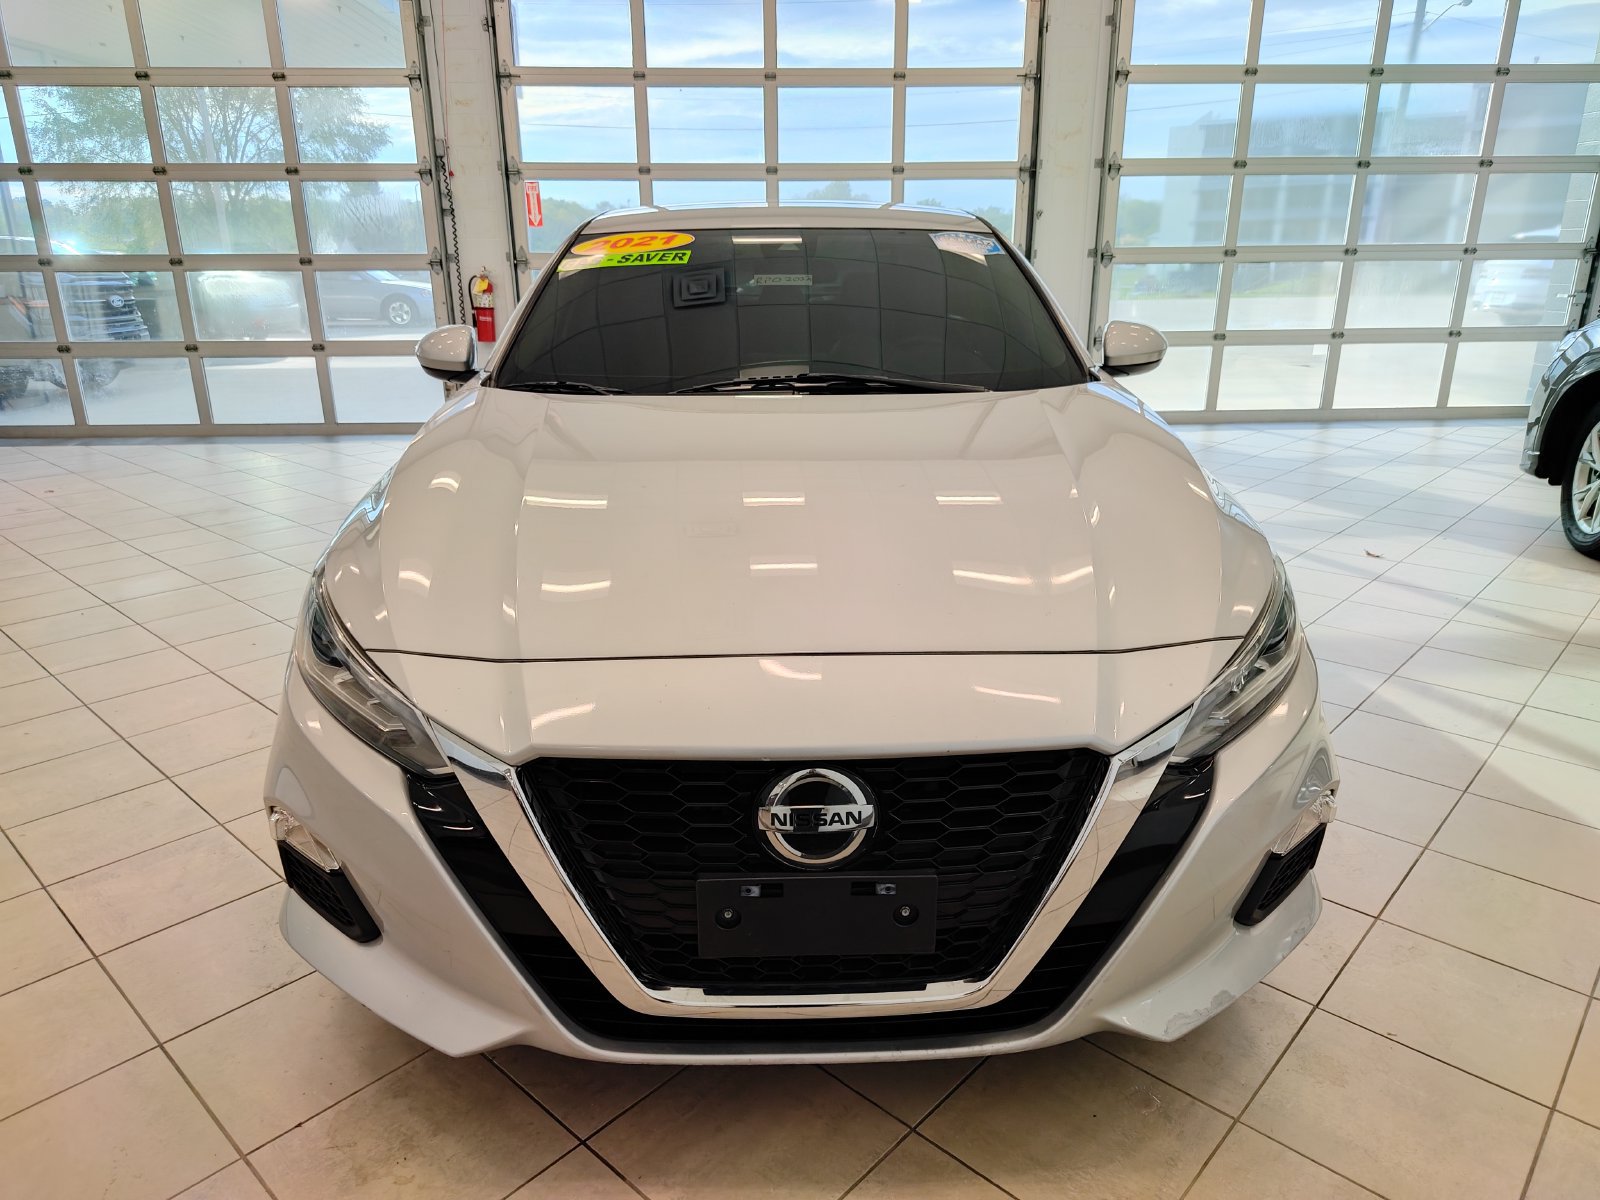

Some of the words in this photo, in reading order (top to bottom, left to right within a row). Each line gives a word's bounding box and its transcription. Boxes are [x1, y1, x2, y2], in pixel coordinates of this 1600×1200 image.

[583, 234, 679, 253] 2021
[616, 252, 687, 264] SAVER
[770, 811, 862, 827] NISSAN
